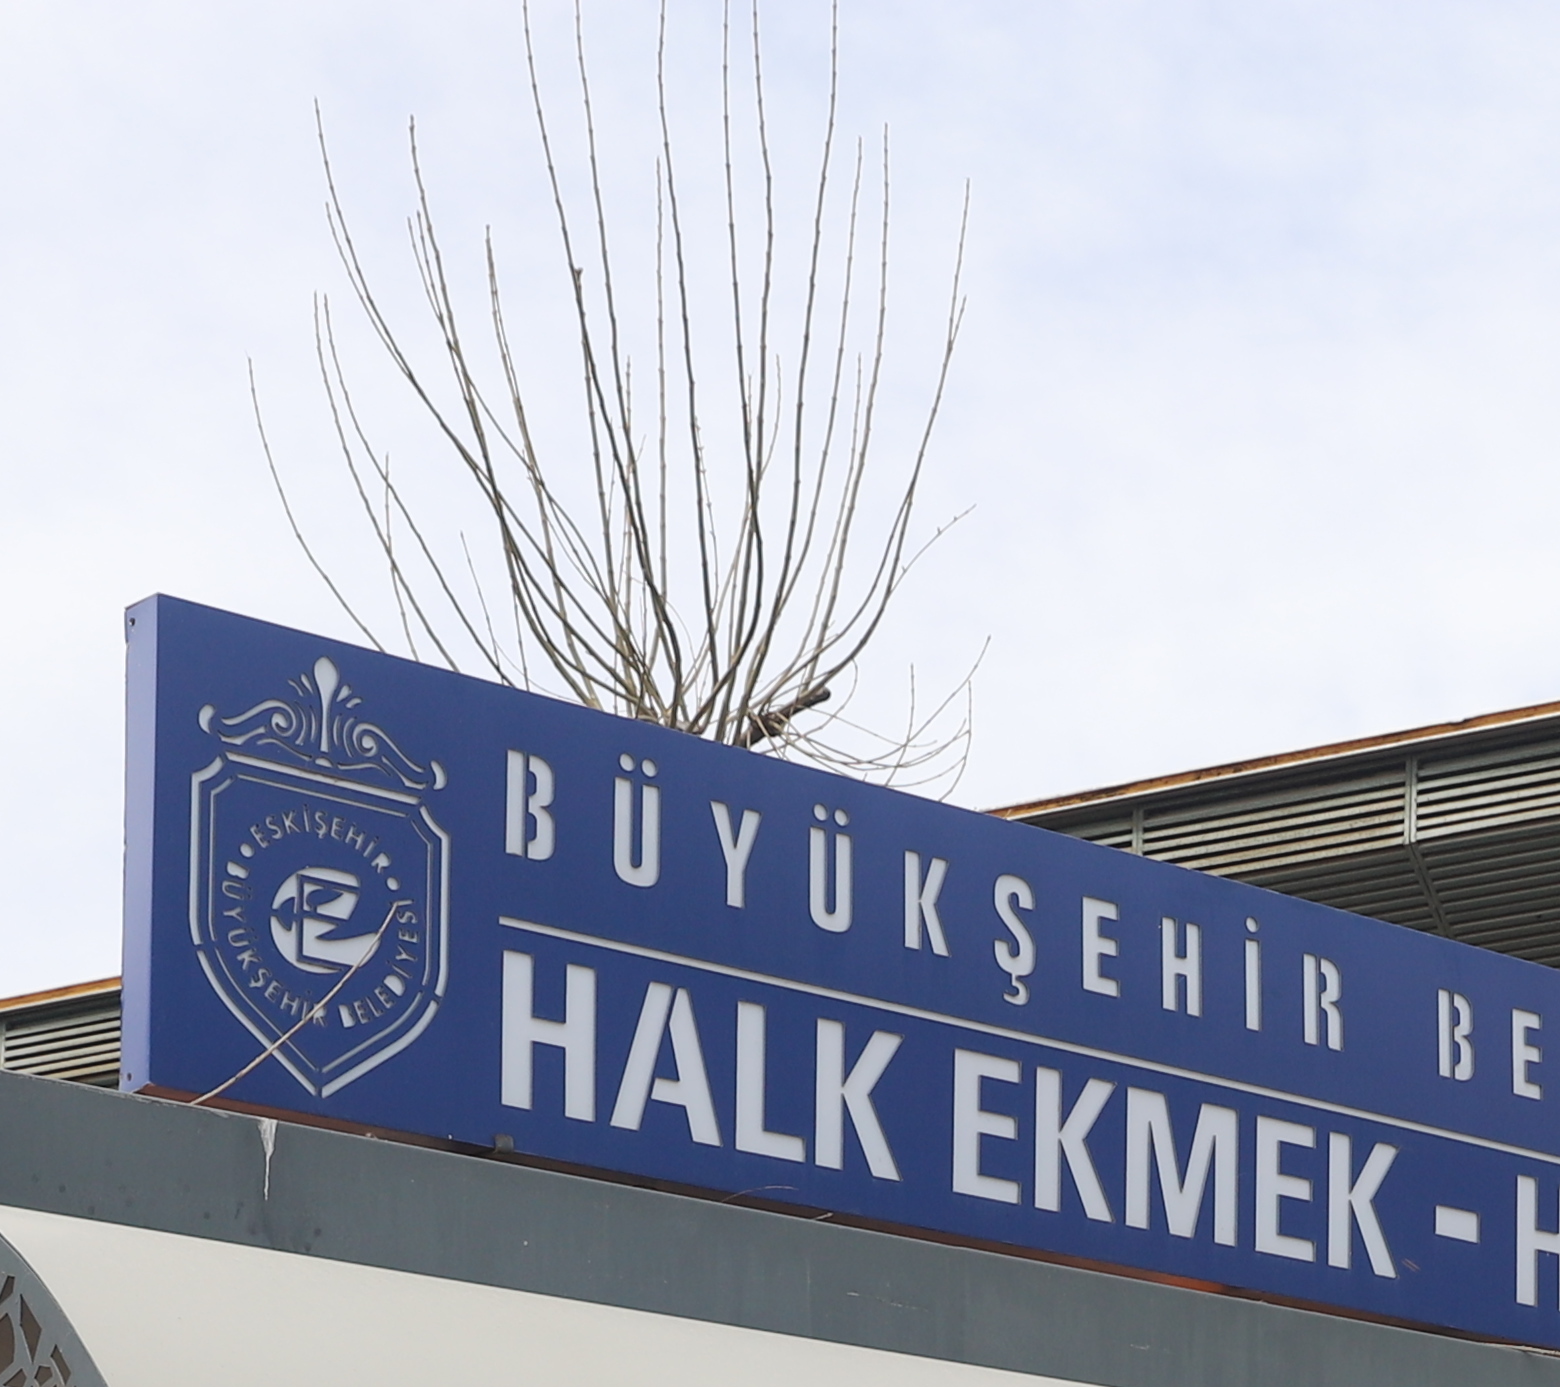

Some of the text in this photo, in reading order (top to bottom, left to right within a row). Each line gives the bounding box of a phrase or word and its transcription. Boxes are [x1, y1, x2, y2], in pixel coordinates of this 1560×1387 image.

[222, 860, 420, 1029] BÜYÜKŞEHİR BELEDİYESİ
[250, 804, 391, 875] ESKİŞEHİR
[504, 748, 1344, 1053] BÜYÜKŞEHİR
[501, 949, 902, 1184] HALK
[953, 1055, 1401, 1280] EKMEK
